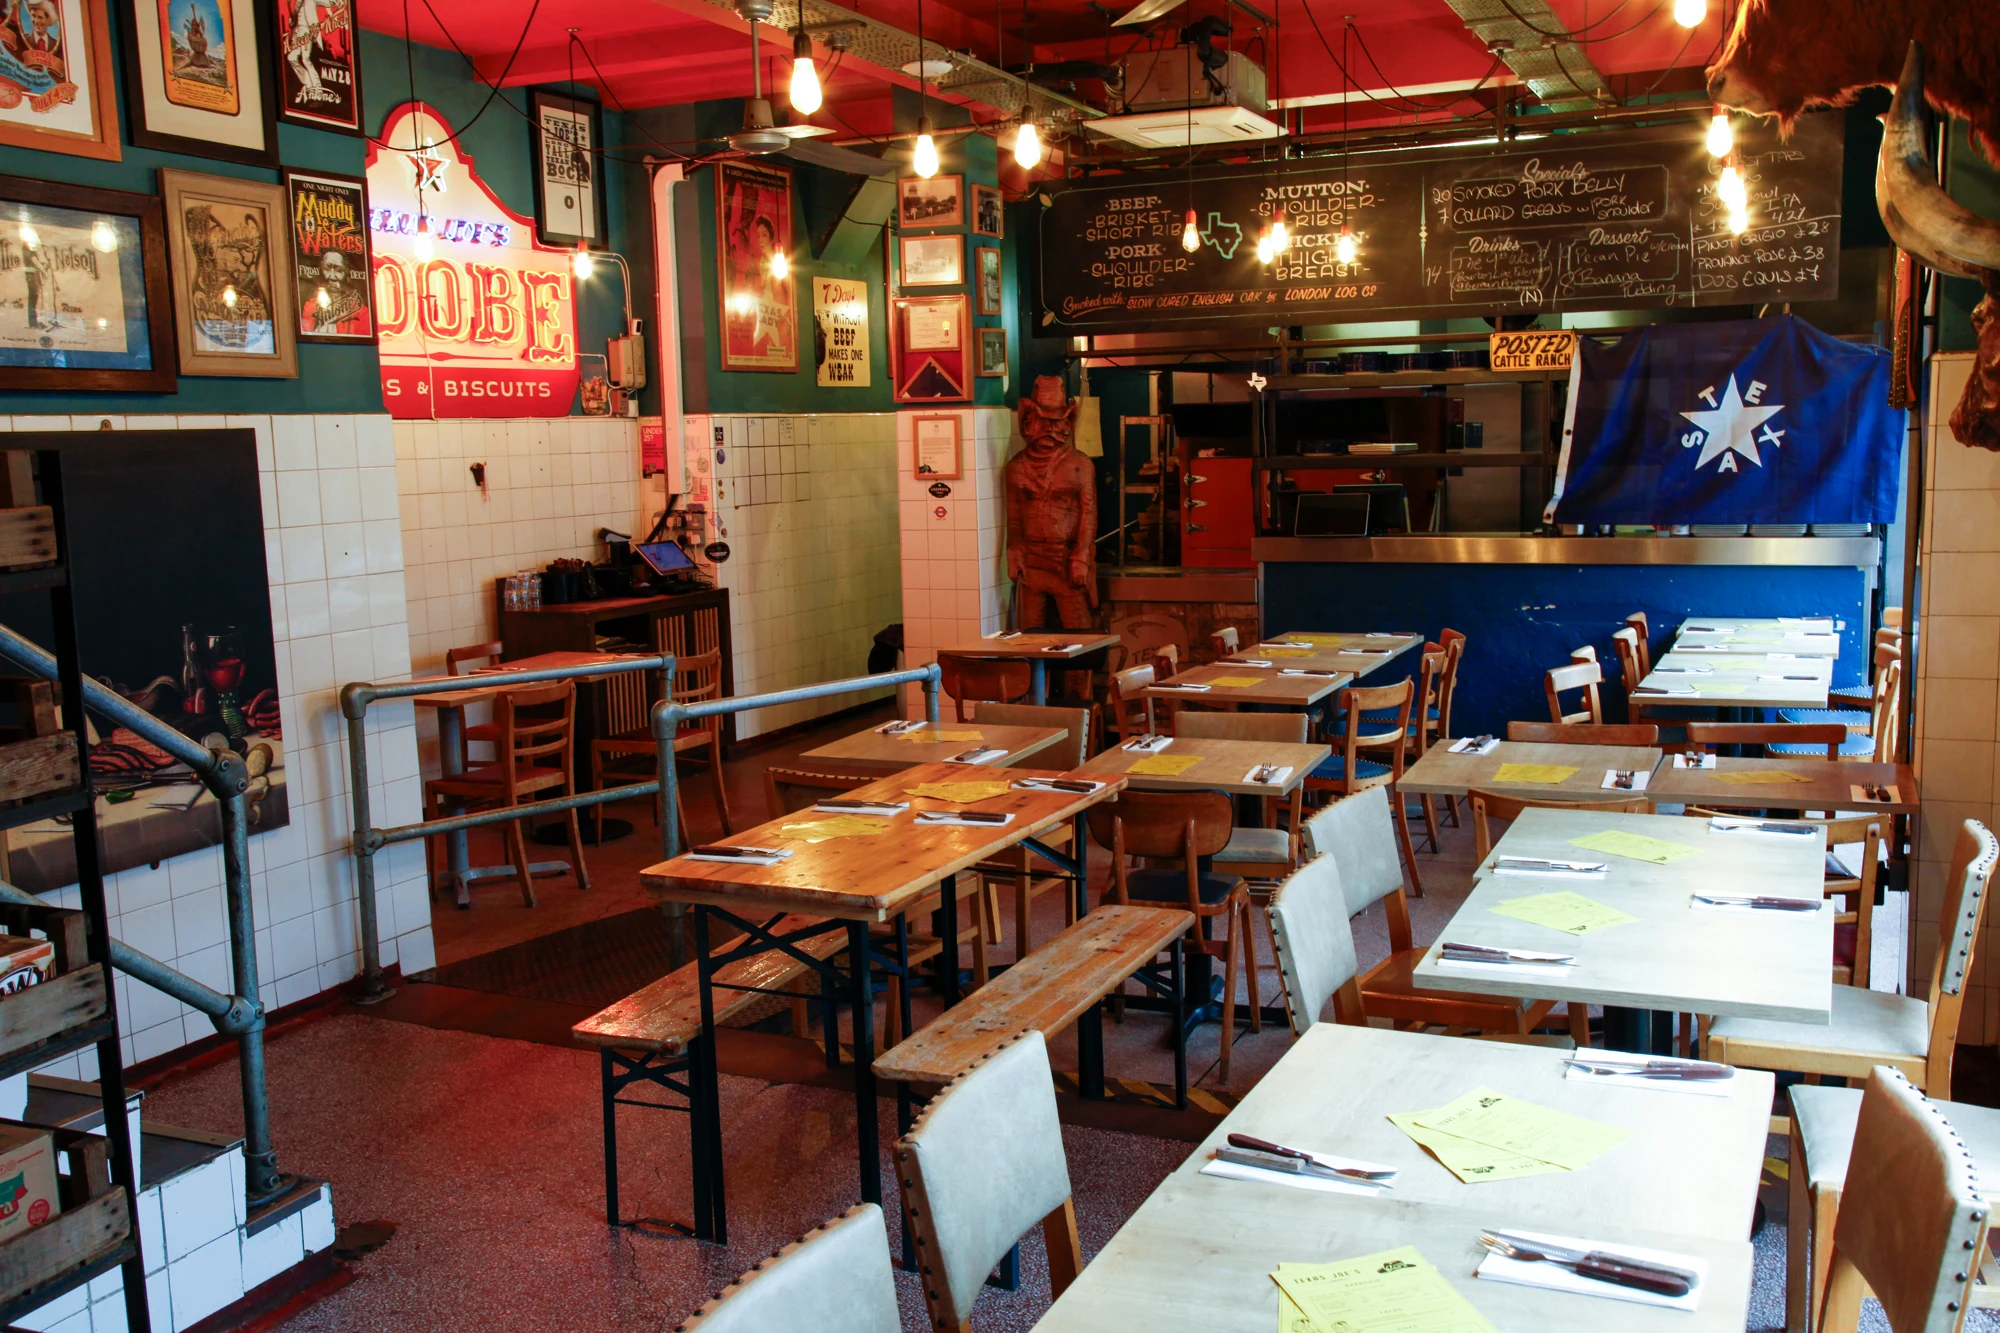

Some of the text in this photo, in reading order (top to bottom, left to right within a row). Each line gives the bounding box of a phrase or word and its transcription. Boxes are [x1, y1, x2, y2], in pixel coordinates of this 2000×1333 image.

[321, 66, 351, 86] MAY 28
[34, 93, 53, 109] JULY
[543, 118, 587, 133] TEXAS
[545, 144, 569, 159] TALL
[1521, 158, 1591, 184] Specials
[302, 182, 350, 196] ONE NIGHT ONLY
[1109, 180, 1367, 212] BEEF MUTTON
[1432, 174, 1626, 205] 20 SMOKED PORK BELLY
[296, 190, 356, 232] Muddy
[1437, 207, 1450, 225] 7
[1453, 204, 1515, 225] COLLARD
[1521, 203, 1572, 220] GREENS
[1593, 195, 1627, 209] PORK
[370, 207, 512, 247] EXAS JOE'S
[1086, 225, 1146, 242] SHORT
[296, 222, 364, 255] Waters
[1468, 236, 1521, 254] Drinks
[1588, 228, 1653, 247] Dessert
[1694, 238, 1735, 255] PINOT
[1740, 229, 1786, 246] GRIGIO
[1107, 244, 1164, 260] PORK
[1575, 247, 1620, 265] Pecan
[1624, 245, 1651, 263] Pie
[54, 245, 100, 281] Nelson
[299, 264, 320, 279] FRIDAY
[1453, 257, 1483, 271] The
[1576, 268, 1645, 286] Banana
[1694, 274, 1739, 290] DOS
[1742, 267, 1792, 288] EQUIS
[822, 283, 856, 307] 7 Days
[1062, 292, 1103, 316] Smoked
[1126, 296, 1155, 310] SLOW
[1156, 295, 1189, 308] CURED
[1191, 293, 1235, 307] ENGLISH
[1239, 291, 1263, 304] OAK
[1284, 287, 1333, 301] LONDON
[1334, 286, 1358, 299] LOG
[1620, 280, 1677, 306] Pudding
[757, 303, 783, 318] EXAS
[832, 312, 862, 327] WITHOUT
[759, 314, 780, 328] ADY
[833, 327, 856, 347] BEEF
[1493, 333, 1573, 355] POSTED
[828, 348, 864, 361] MAKES ONE
[1494, 352, 1571, 368] CATTLE RANCH
[828, 362, 855, 382] WEAK
[416, 381, 429, 395] &
[443, 379, 552, 398] BISCUITS
[1293, 1268, 1362, 1286] TEXAS JOE'S
